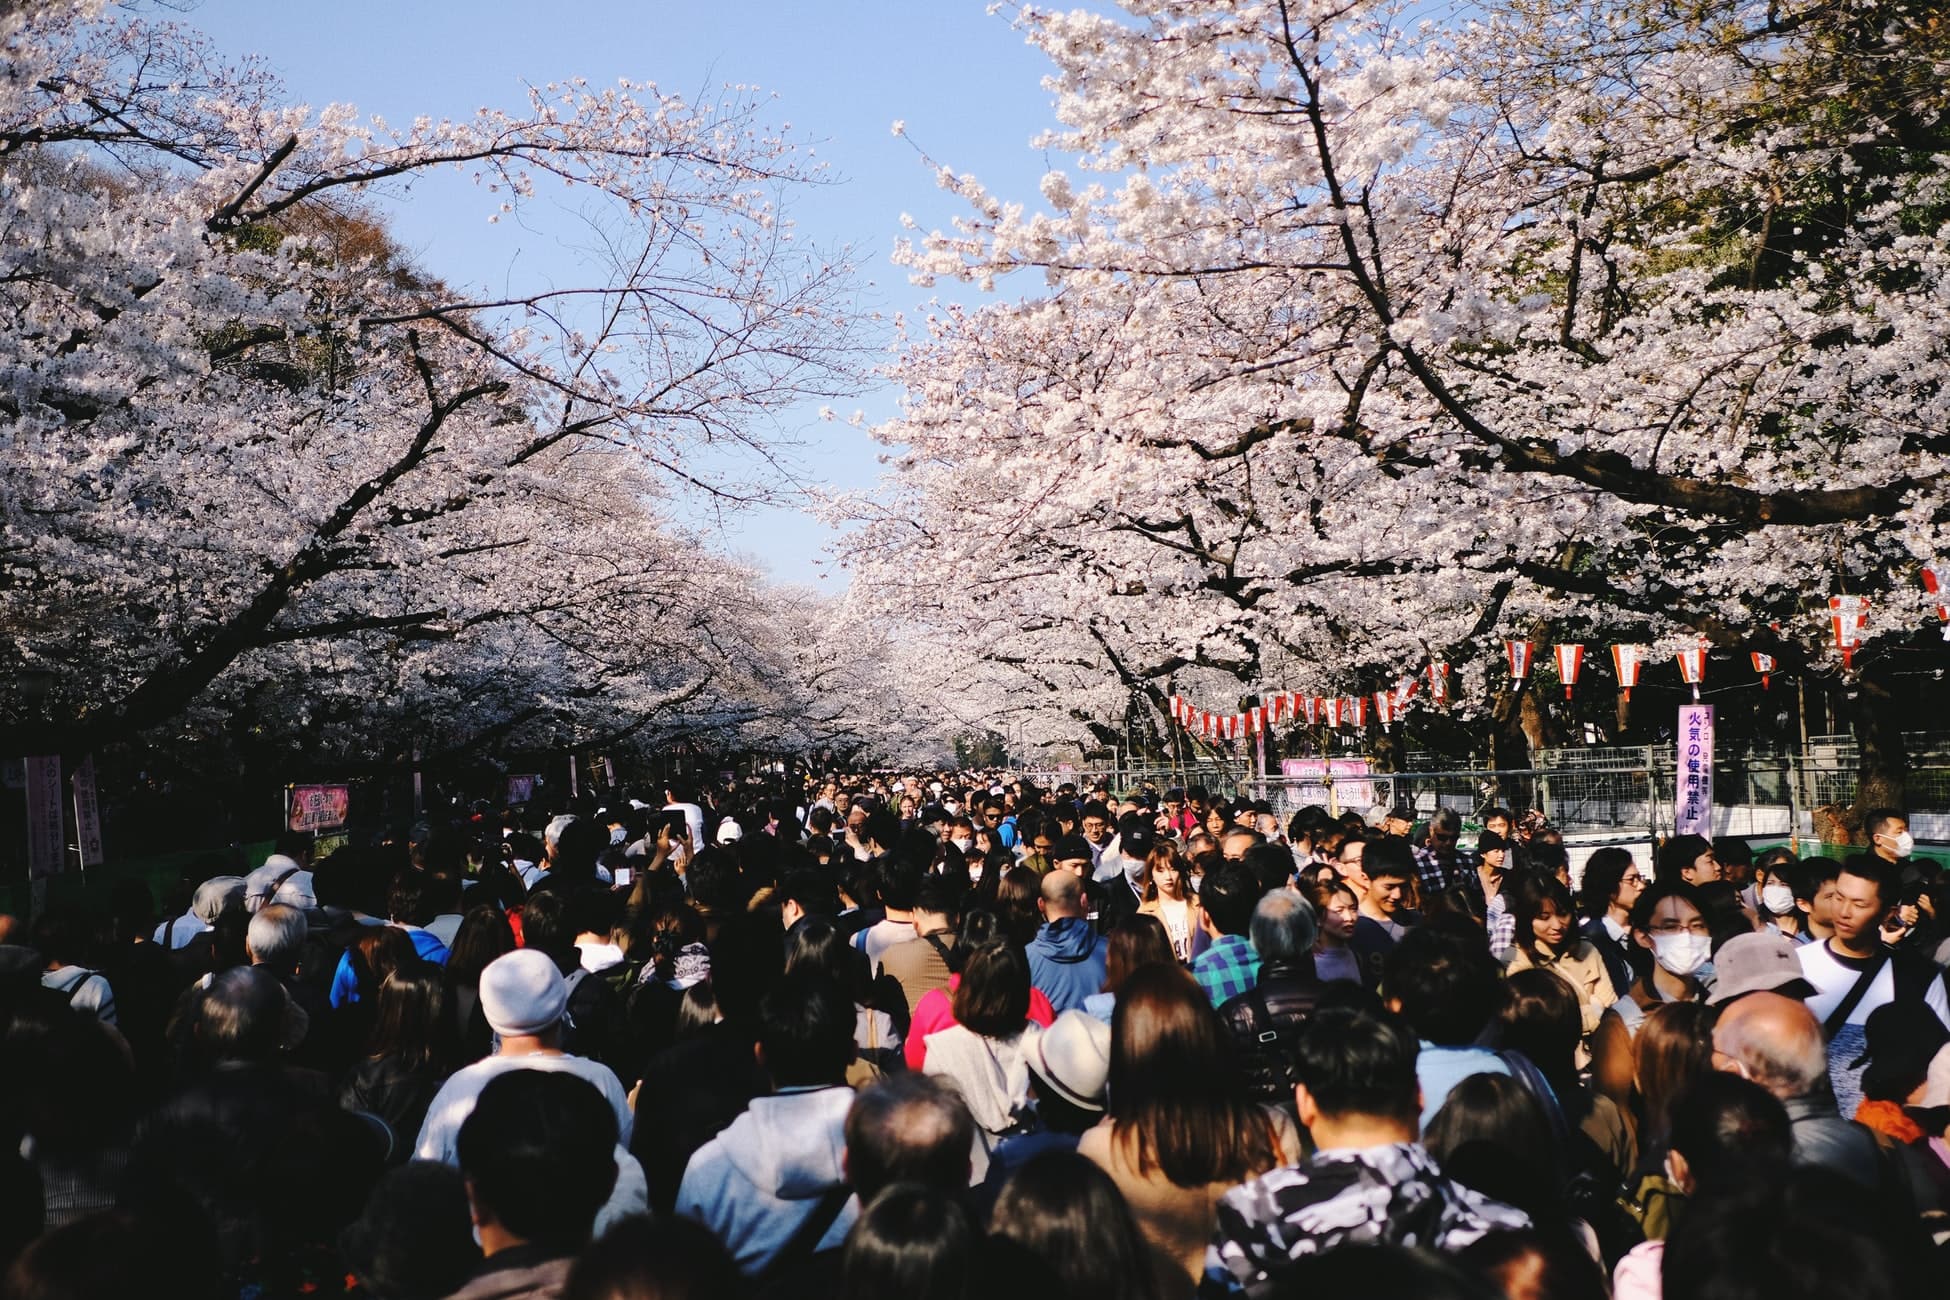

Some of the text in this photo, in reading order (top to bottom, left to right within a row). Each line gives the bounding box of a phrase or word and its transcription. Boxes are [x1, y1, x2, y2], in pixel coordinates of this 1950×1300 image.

[1686, 711, 1701, 821] 火気の使用禁止
